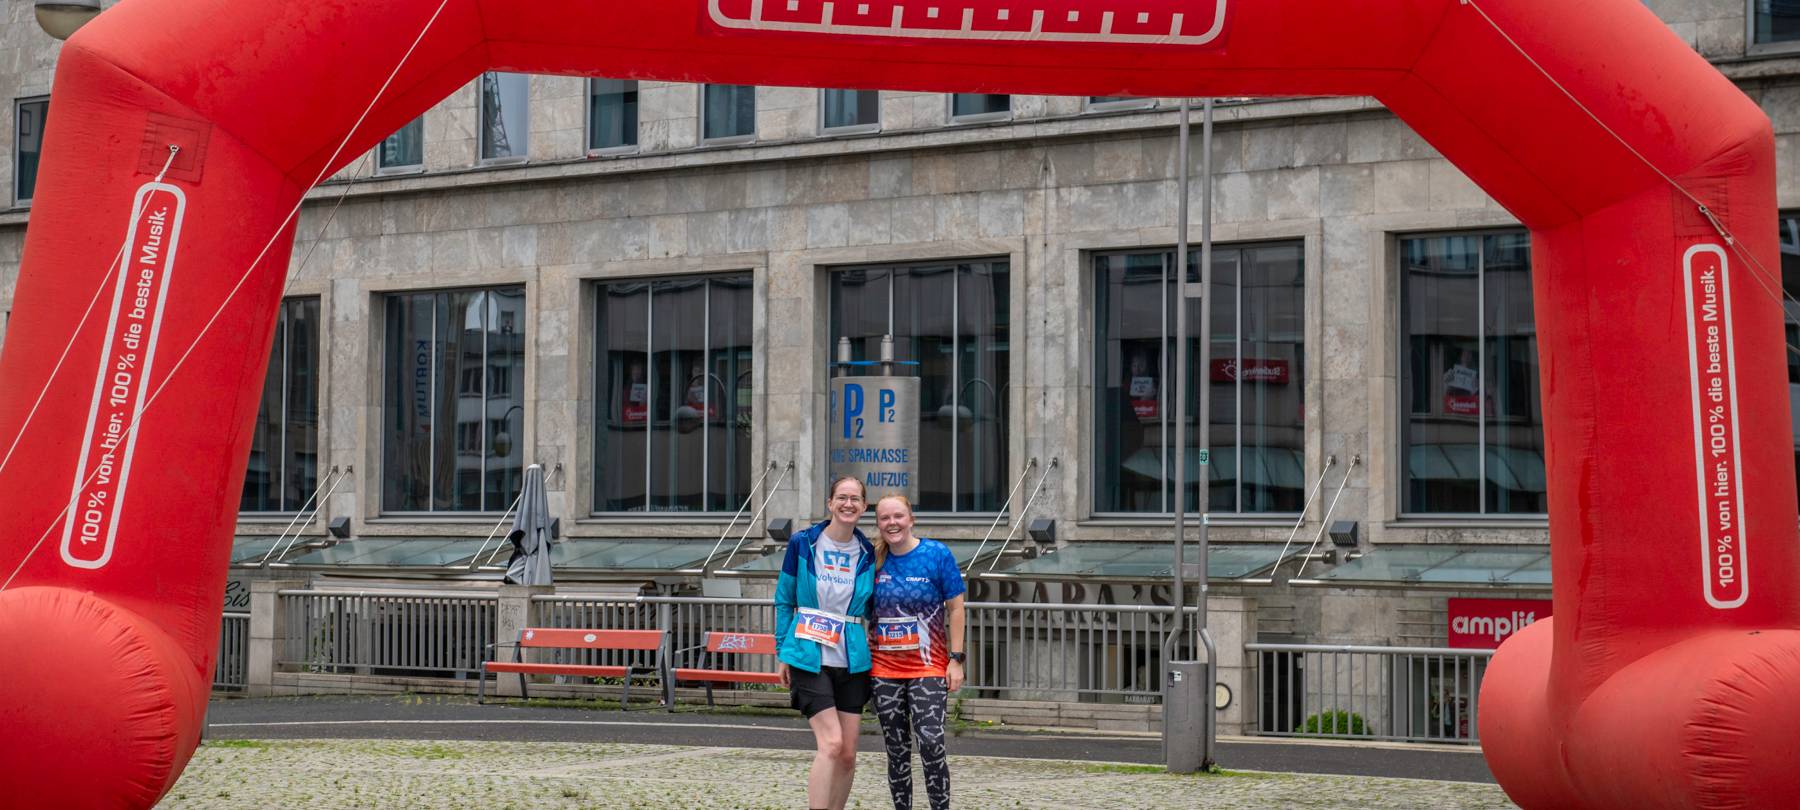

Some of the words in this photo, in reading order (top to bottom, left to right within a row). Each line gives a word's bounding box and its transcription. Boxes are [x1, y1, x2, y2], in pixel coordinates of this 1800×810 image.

[140, 206, 167, 265] Musik.
[128, 269, 154, 319] beste
[1700, 265, 1717, 322] Musik.
[123, 322, 142, 349] die
[1706, 325, 1721, 374] beste
[110, 354, 136, 407] 100%
[1708, 377, 1724, 402] die
[101, 411, 124, 449] hier.
[1709, 405, 1727, 458] 100%
[97, 454, 115, 485] von
[848, 448, 909, 463] SPARKASSE
[866, 471, 909, 487] AUFZUG
[1714, 460, 1729, 497] hier.
[80, 490, 107, 545] 100%
[1719, 500, 1732, 530] von
[1717, 535, 1734, 588] 100%
